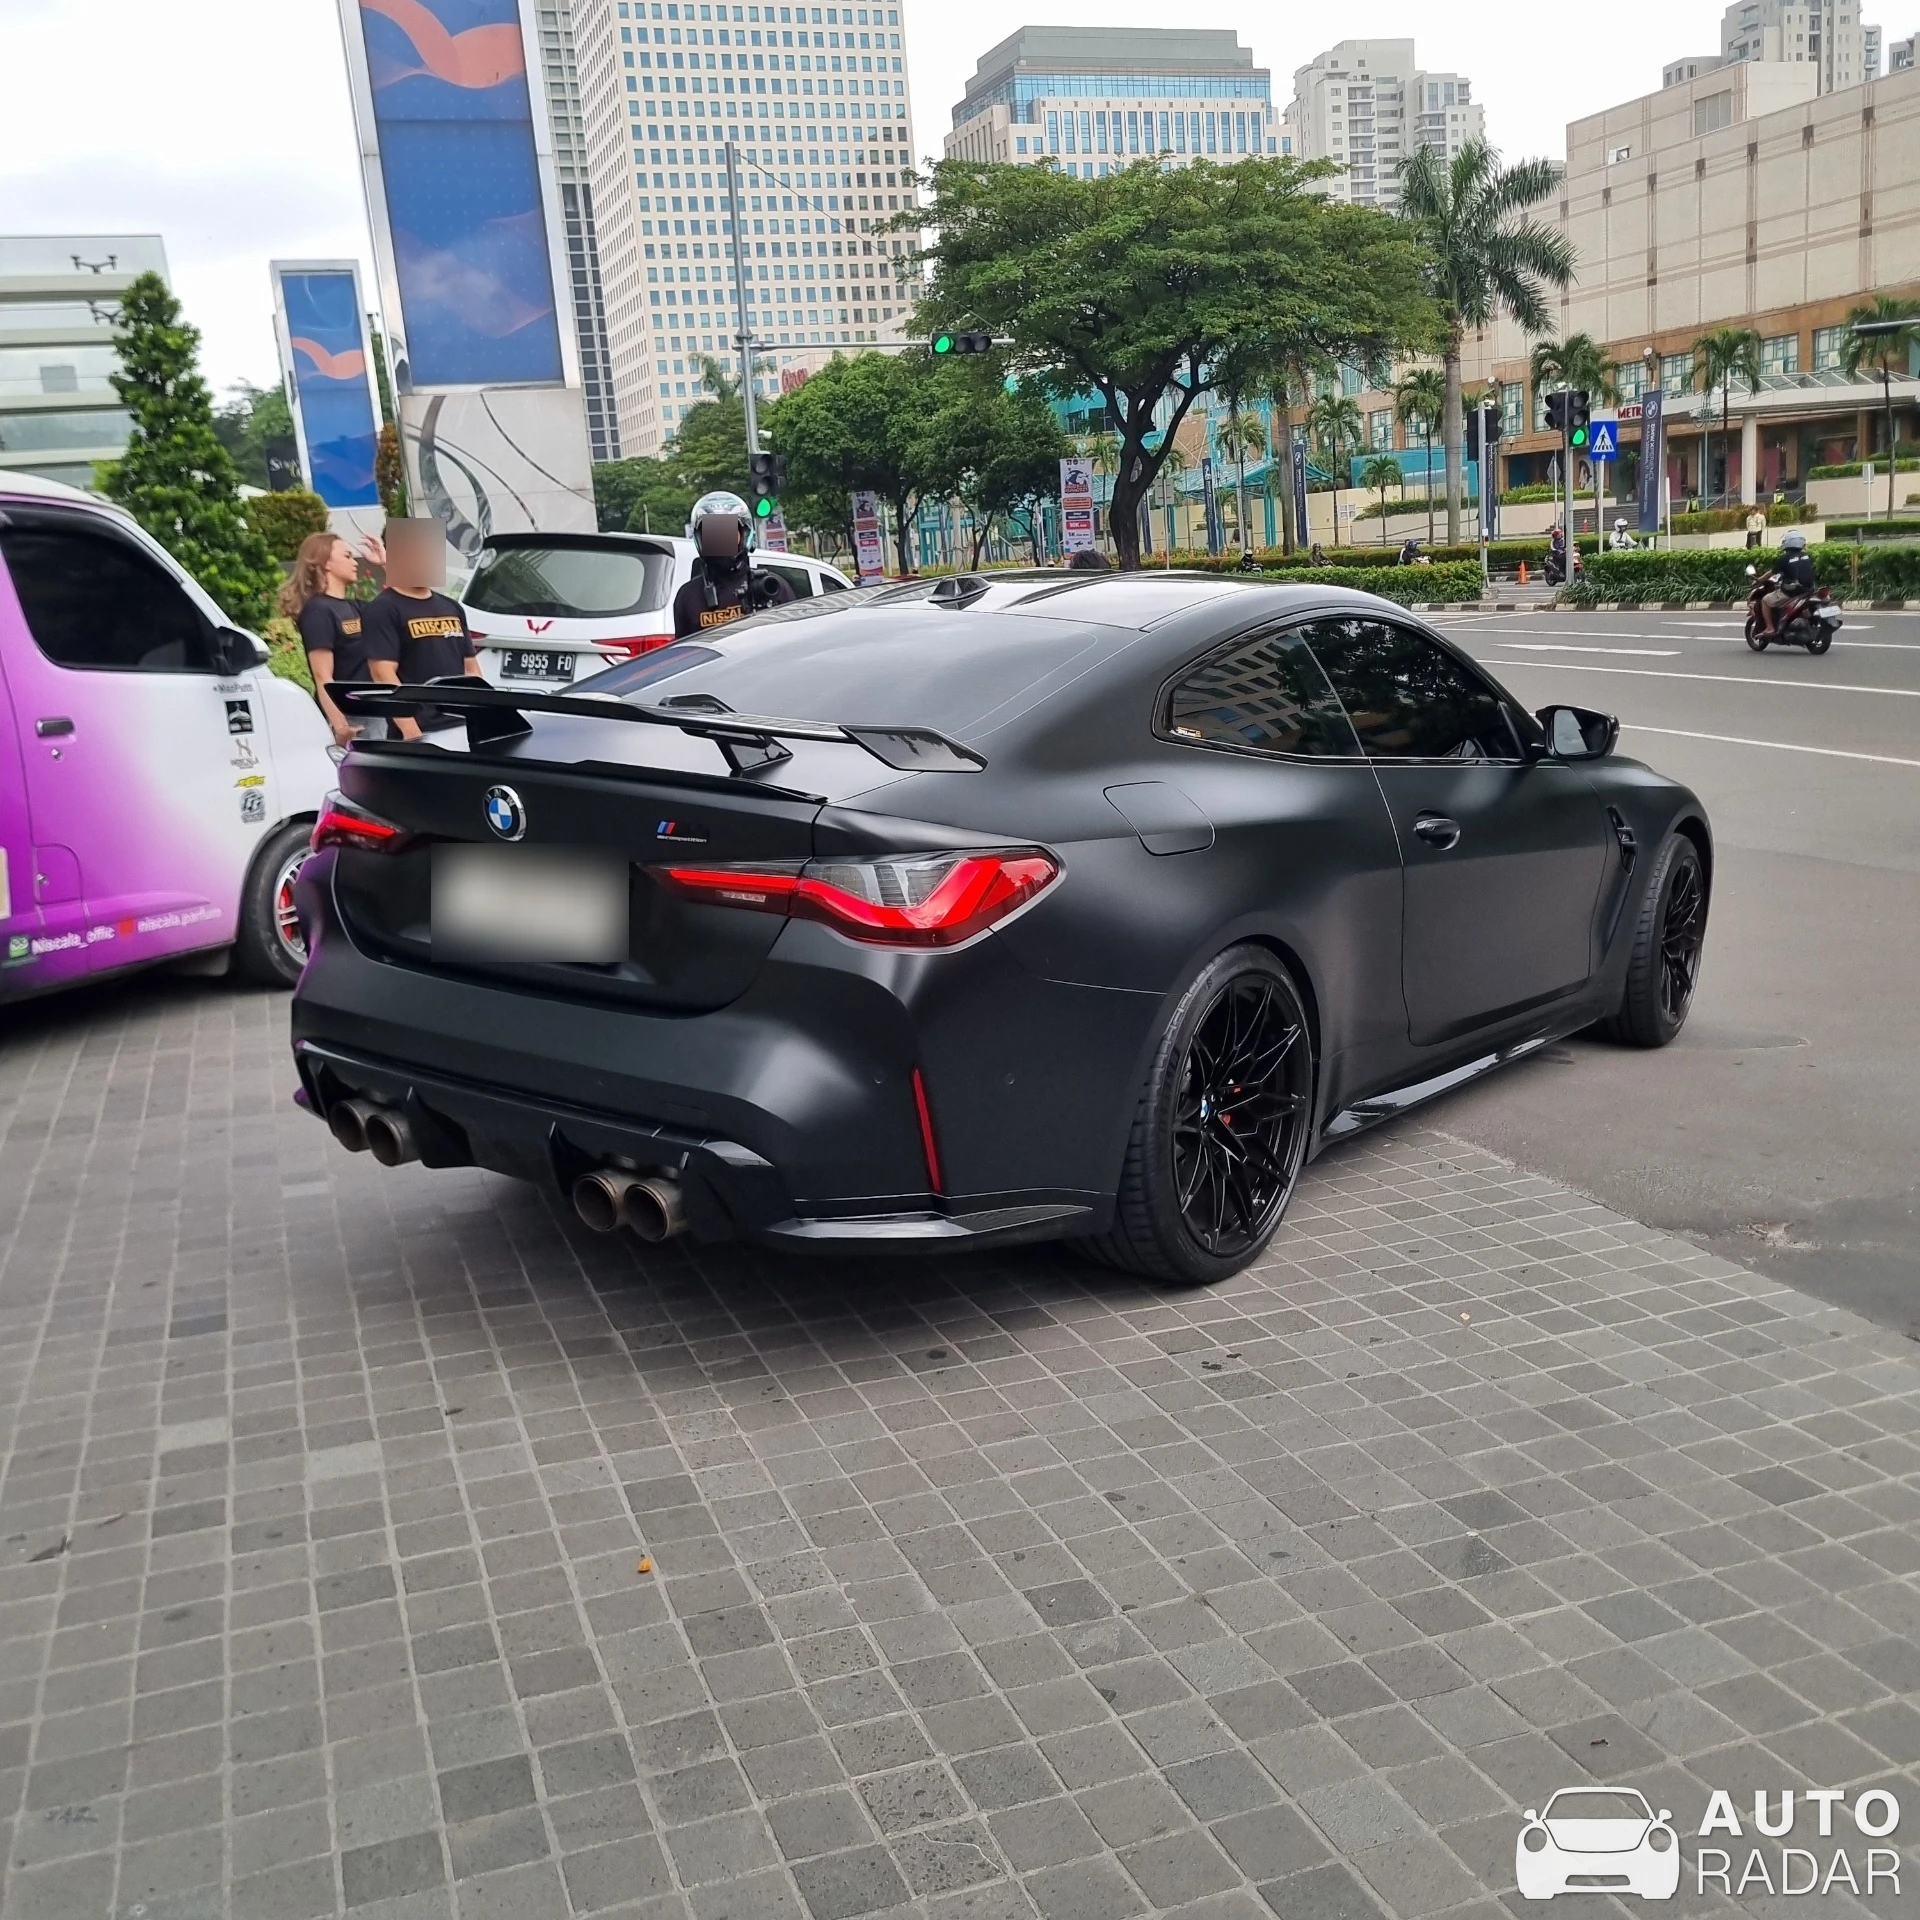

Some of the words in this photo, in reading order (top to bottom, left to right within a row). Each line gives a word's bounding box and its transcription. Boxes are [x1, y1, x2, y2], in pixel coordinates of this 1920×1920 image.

[1618, 406, 1643, 419] METR
[702, 604, 744, 625] NISCAL
[504, 652, 513, 667] F
[521, 653, 549, 669] 9955
